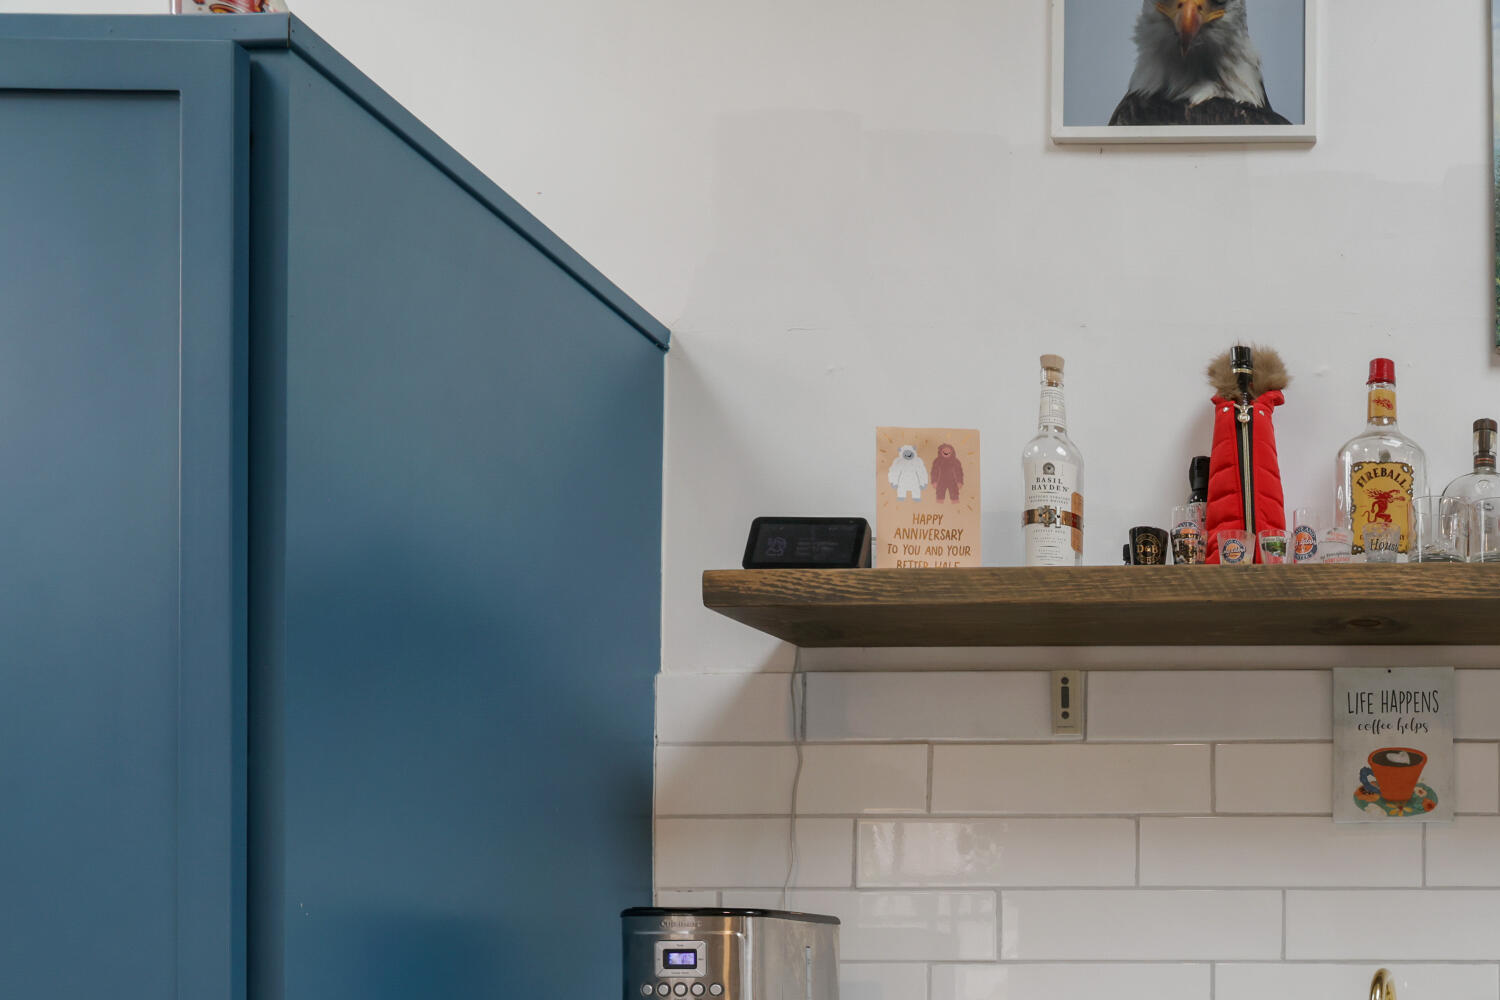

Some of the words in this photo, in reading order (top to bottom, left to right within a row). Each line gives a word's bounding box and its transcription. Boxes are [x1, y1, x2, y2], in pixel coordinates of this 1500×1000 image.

[1036, 477, 1063, 485] BASIL
[1356, 467, 1407, 488] FIREBALL
[1031, 484, 1069, 492] HAYDEN
[912, 513, 943, 526] HAPPY
[893, 527, 964, 541] ANNIVERSARY
[887, 543, 898, 555] TO
[903, 543, 921, 557] YOU
[925, 545, 943, 557] AND
[946, 545, 971, 557] YOUR
[896, 559, 929, 568] BETTER
[1347, 691, 1374, 715] LIFE
[1381, 689, 1440, 714] HAPPENS
[1357, 719, 1392, 735] coffee
[1396, 717, 1429, 734] helps
